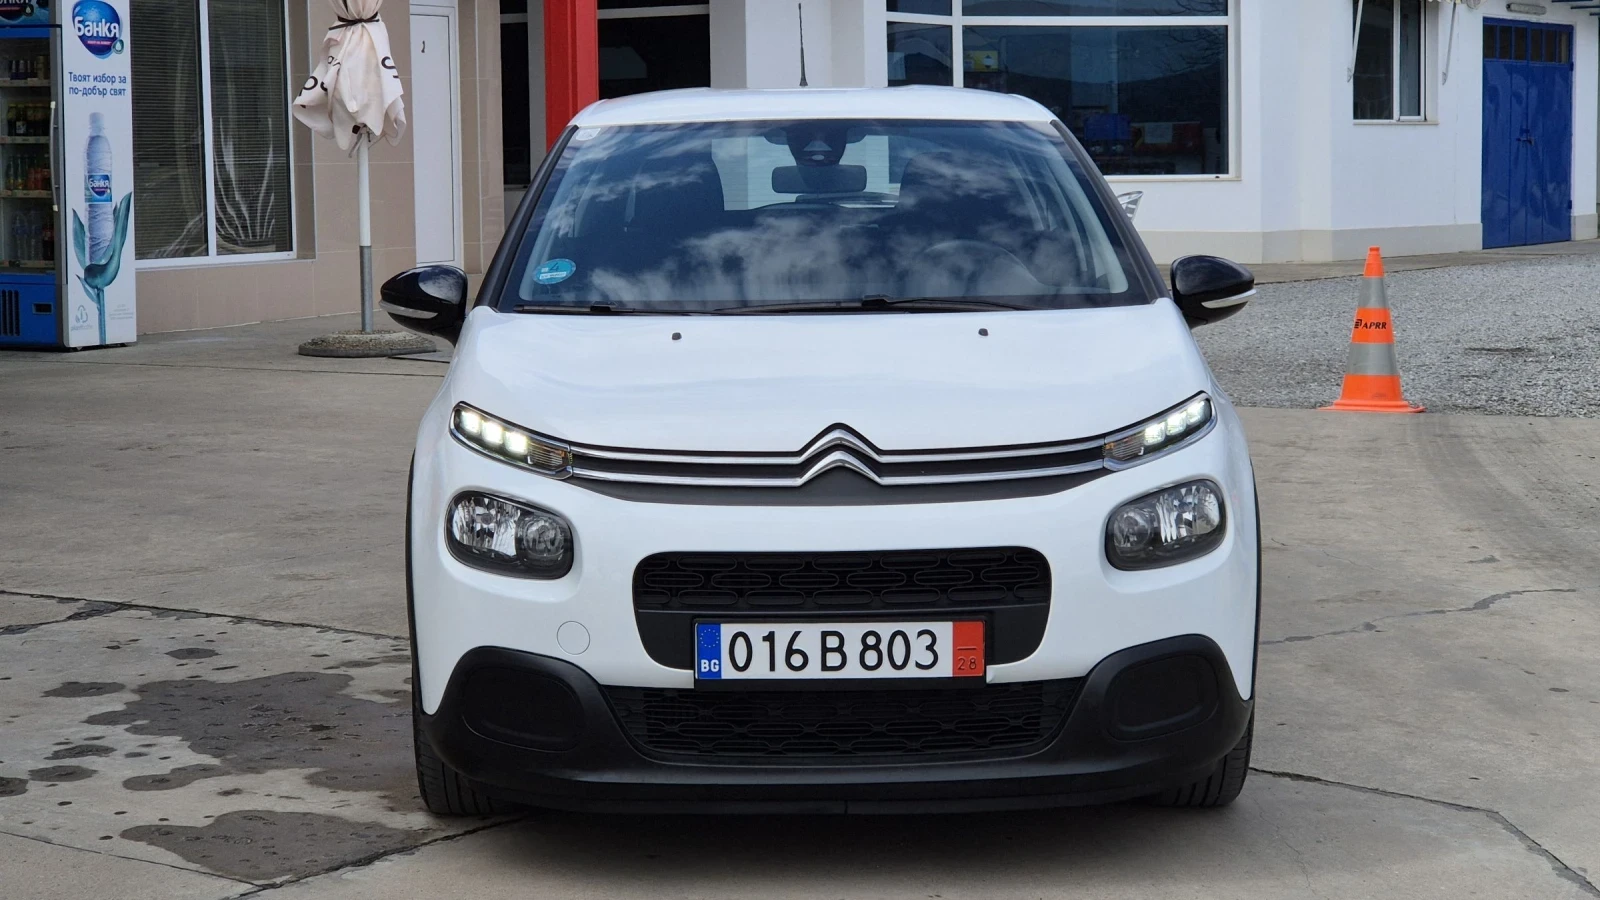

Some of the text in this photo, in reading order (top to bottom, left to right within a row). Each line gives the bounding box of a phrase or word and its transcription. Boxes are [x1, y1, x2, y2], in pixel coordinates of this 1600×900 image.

[68, 72, 127, 86] Твоят избор за
[69, 86, 126, 98] по-добър свят
[1362, 321, 1387, 330] APRR
[728, 630, 809, 673] 016
[858, 629, 939, 672] 803
[700, 659, 720, 673] BG
[957, 657, 977, 670] 28
